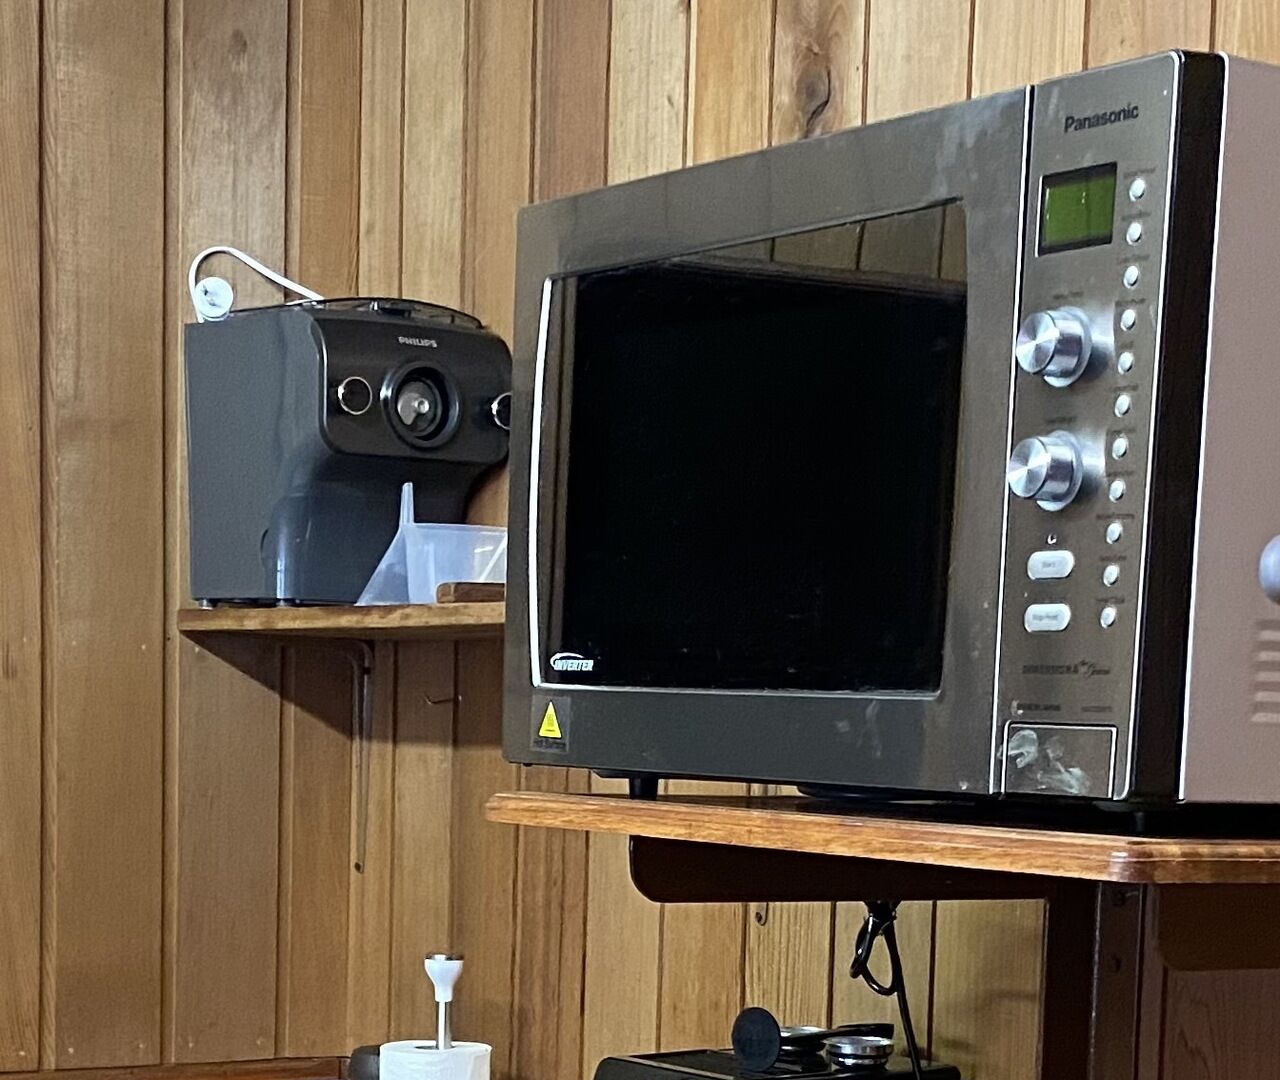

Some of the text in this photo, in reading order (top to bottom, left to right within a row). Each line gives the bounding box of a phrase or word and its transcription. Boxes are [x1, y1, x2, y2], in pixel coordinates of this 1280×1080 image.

[1064, 103, 1139, 133] Panasonic
[397, 336, 438, 348] PHILIPS
[554, 659, 594, 672] INVERTER
